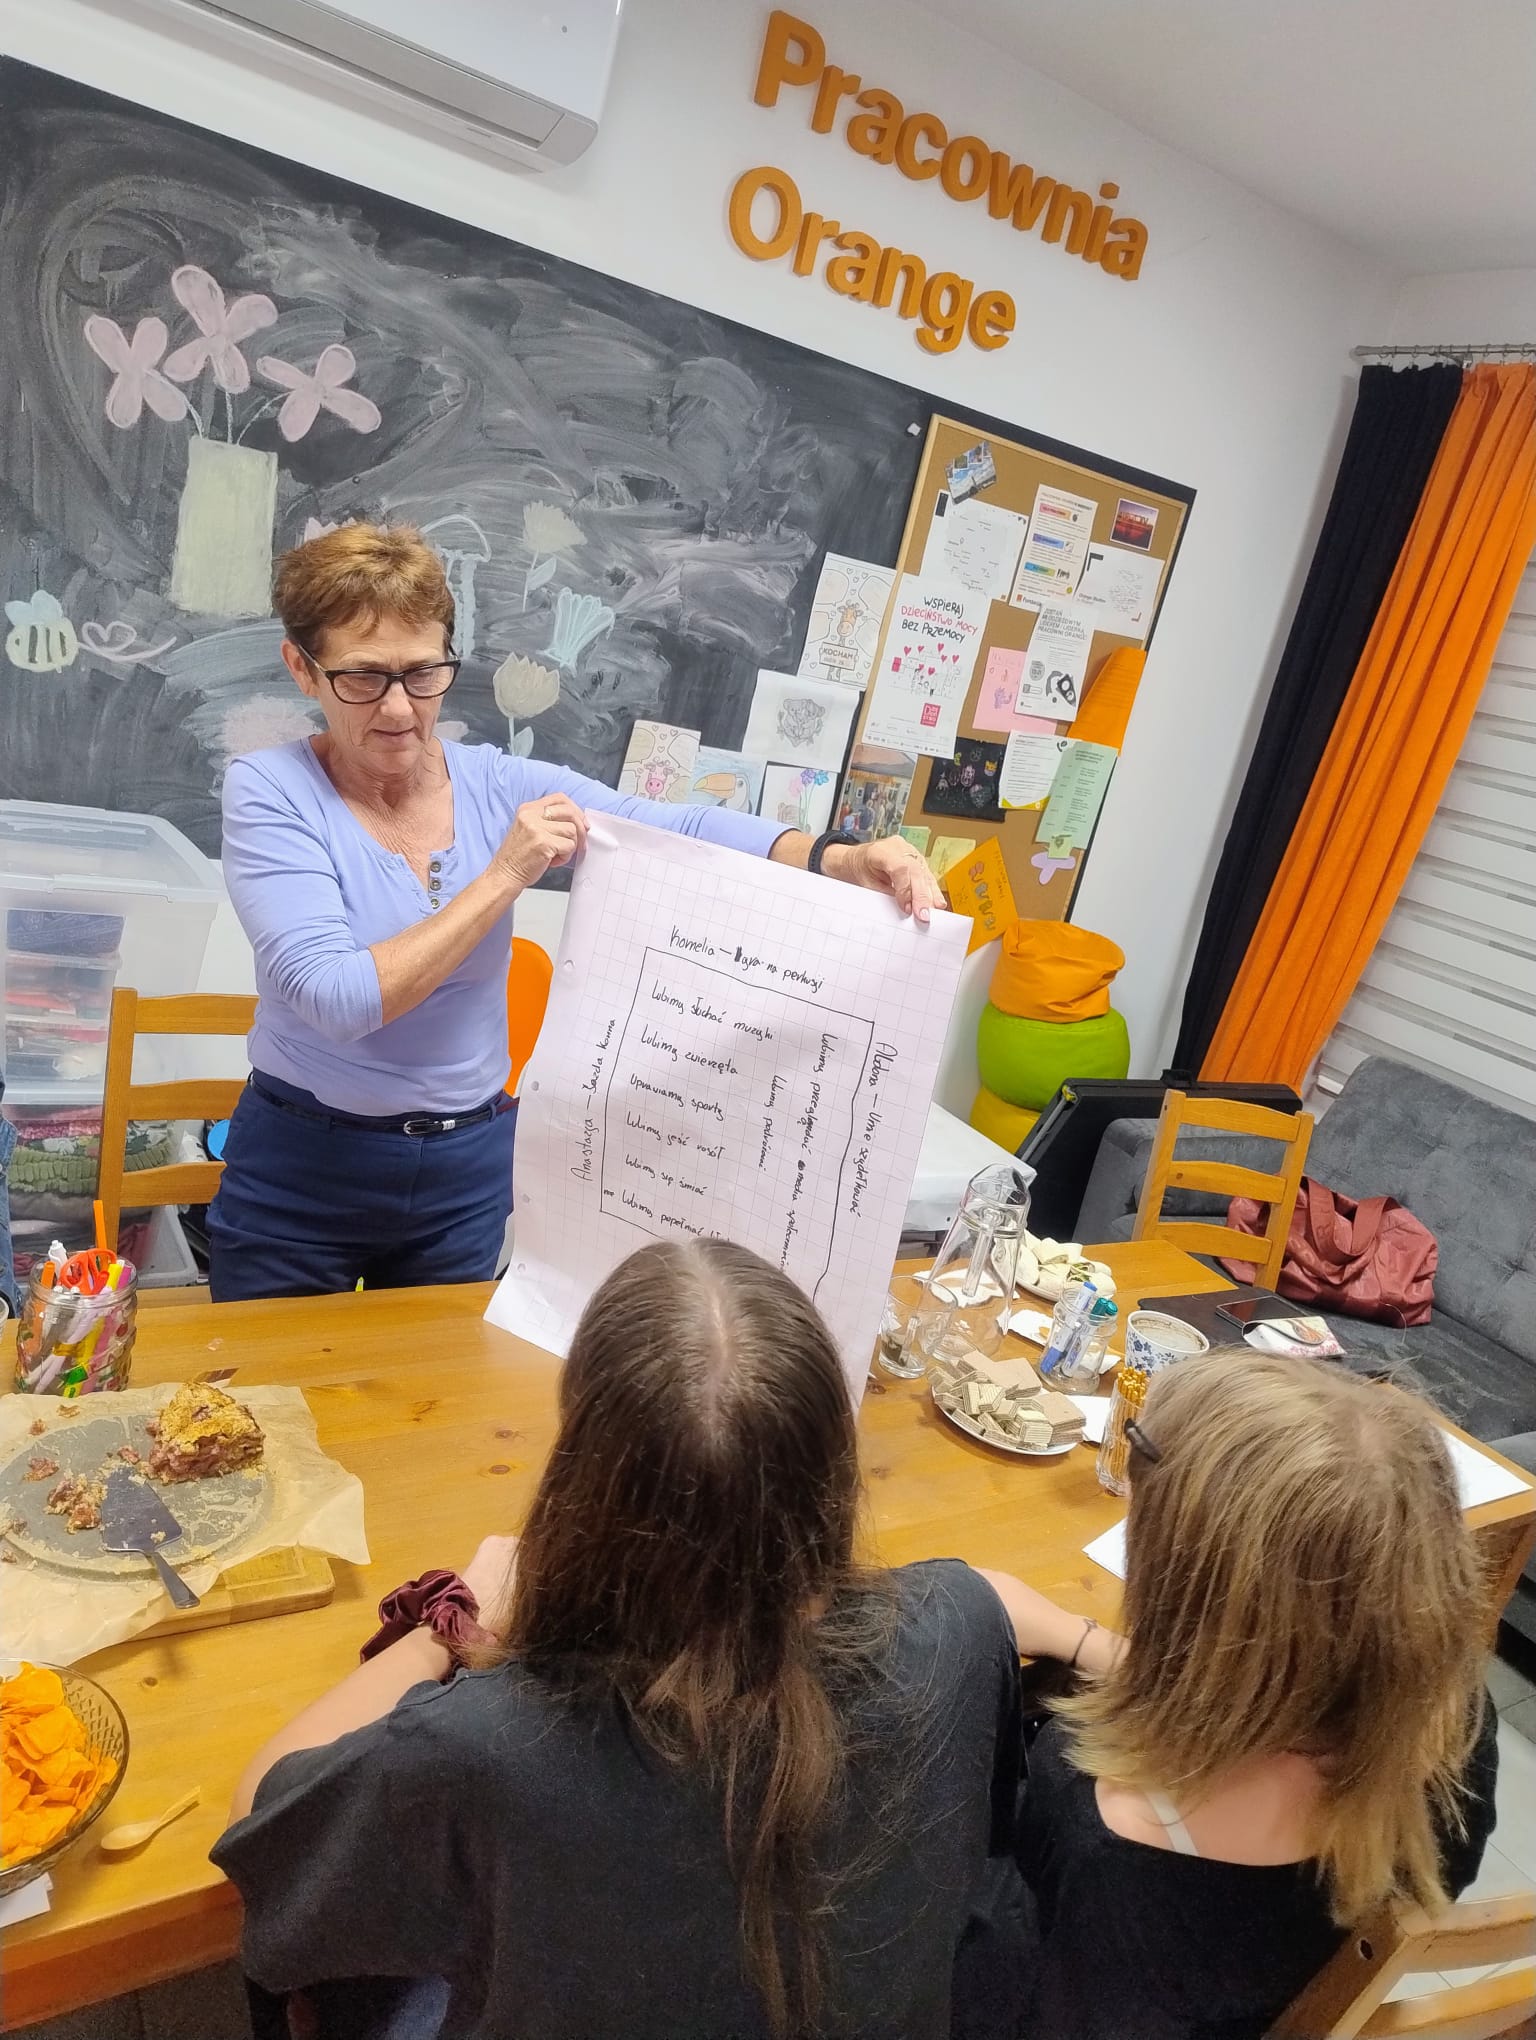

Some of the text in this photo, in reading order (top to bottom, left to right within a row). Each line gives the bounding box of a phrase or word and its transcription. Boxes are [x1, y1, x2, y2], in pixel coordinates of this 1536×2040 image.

[753, 9, 1149, 281] Pracownia
[728, 166, 1016, 354] Orange
[766, 962, 778, 973] na
[651, 978, 685, 1015] Lubimy
[691, 996, 727, 1024] słuchać
[640, 1023, 739, 1075] Lubimy zwierzęta
[691, 1098, 724, 1122] sporty
